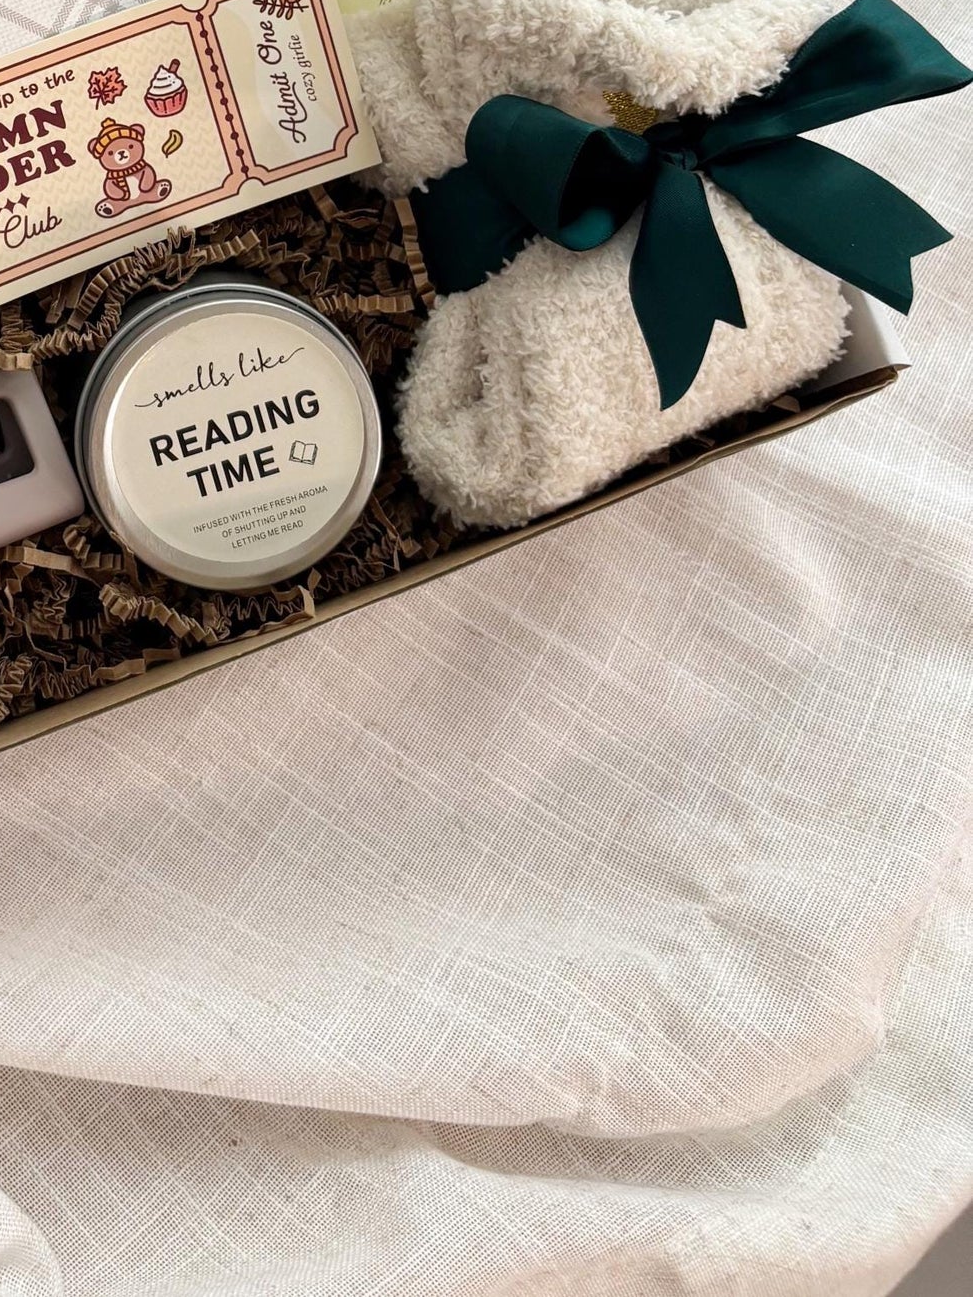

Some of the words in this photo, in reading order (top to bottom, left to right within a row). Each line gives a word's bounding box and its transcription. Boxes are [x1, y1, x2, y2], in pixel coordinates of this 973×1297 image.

[256, 20, 282, 65] One
[288, 34, 313, 68] girlie
[19, 83, 39, 99] to
[44, 69, 76, 90] the
[301, 72, 317, 102] cozy
[270, 71, 308, 144] Admit
[134, 362, 234, 408] smells
[238, 347, 305, 378] like
[149, 389, 320, 467] READING
[187, 445, 280, 498] TIME
[193, 516, 229, 533] INFUSED
[229, 509, 251, 522] WITH
[252, 504, 269, 514] THE
[269, 495, 297, 509] FRESH
[298, 485, 328, 500] AROMA
[221, 529, 233, 538] OF
[234, 515, 276, 534] SHUTTING
[277, 511, 288, 521] UP
[289, 505, 306, 516] AND
[231, 532, 267, 549] LETTING
[267, 526, 280, 537] ME
[281, 519, 304, 532] READ
